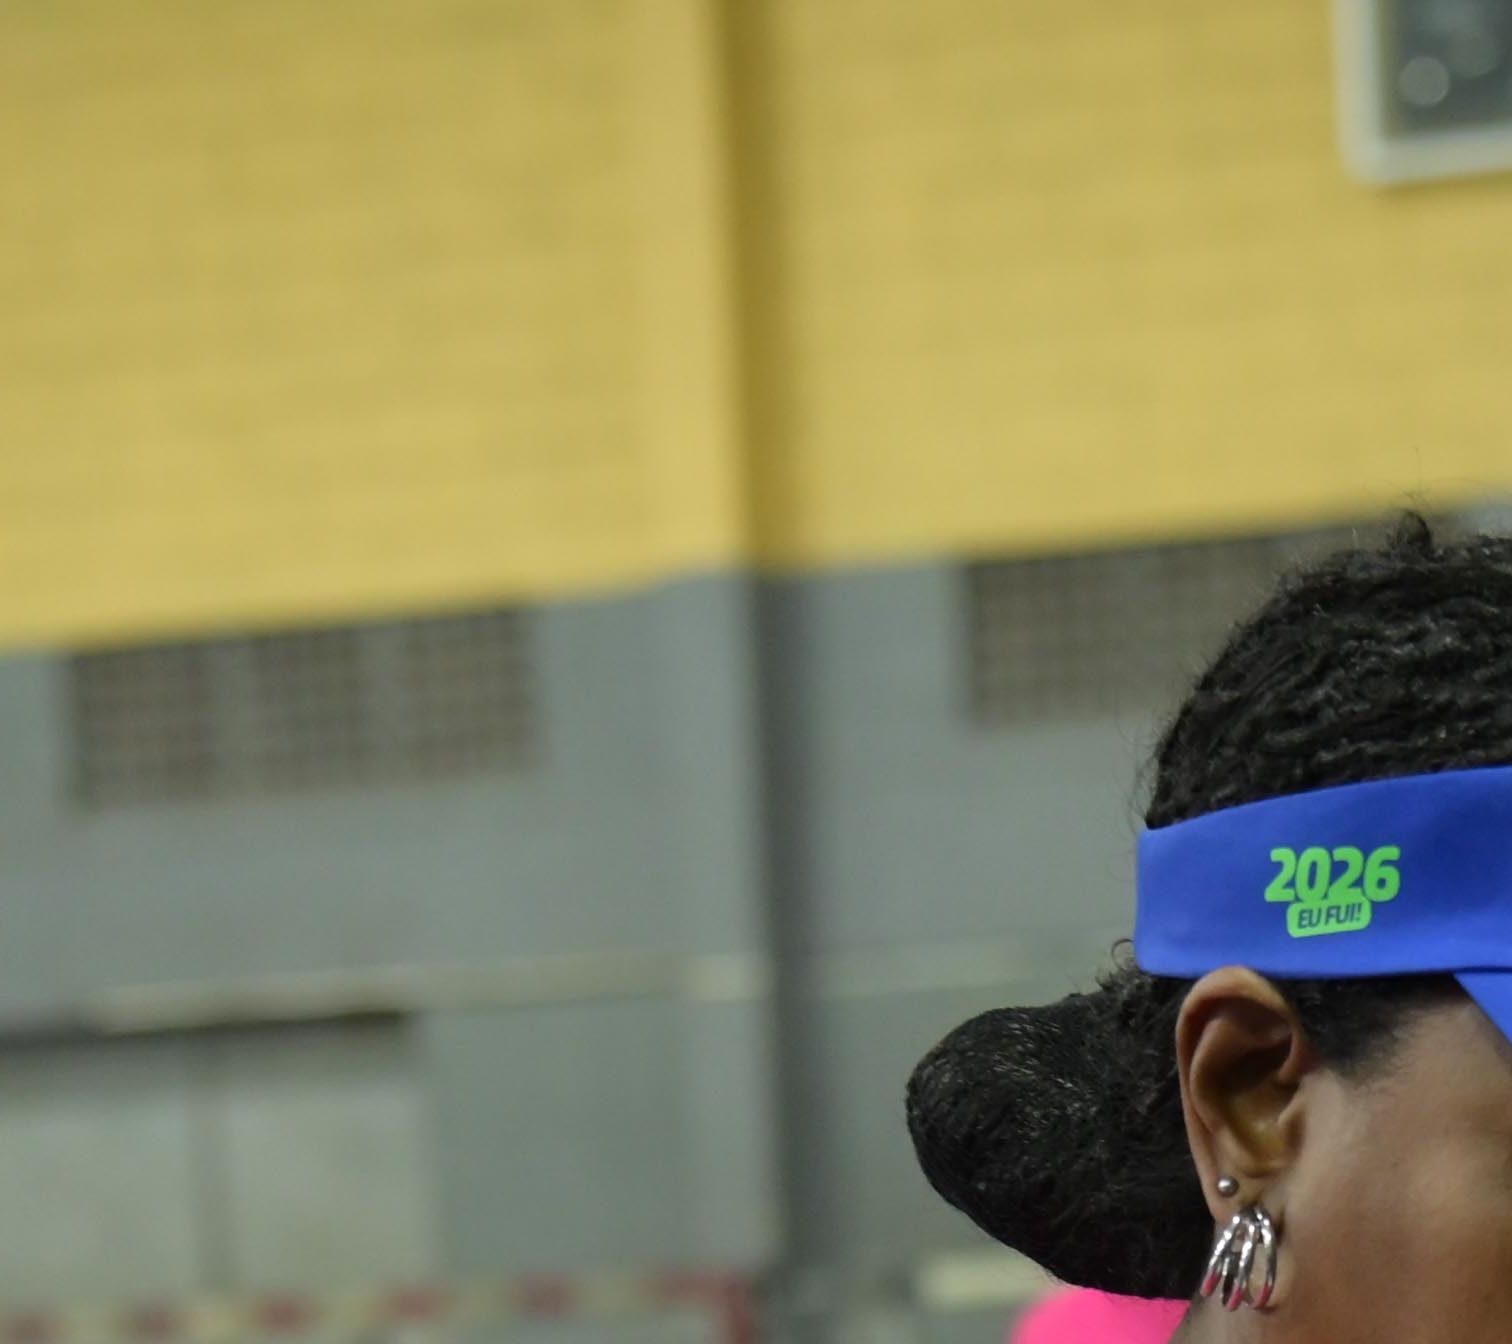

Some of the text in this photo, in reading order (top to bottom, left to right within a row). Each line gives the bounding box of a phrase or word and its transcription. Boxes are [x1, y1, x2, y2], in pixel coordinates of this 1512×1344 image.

[1264, 845, 1400, 902] 2026
[1298, 903, 1362, 929] EU FUI!
